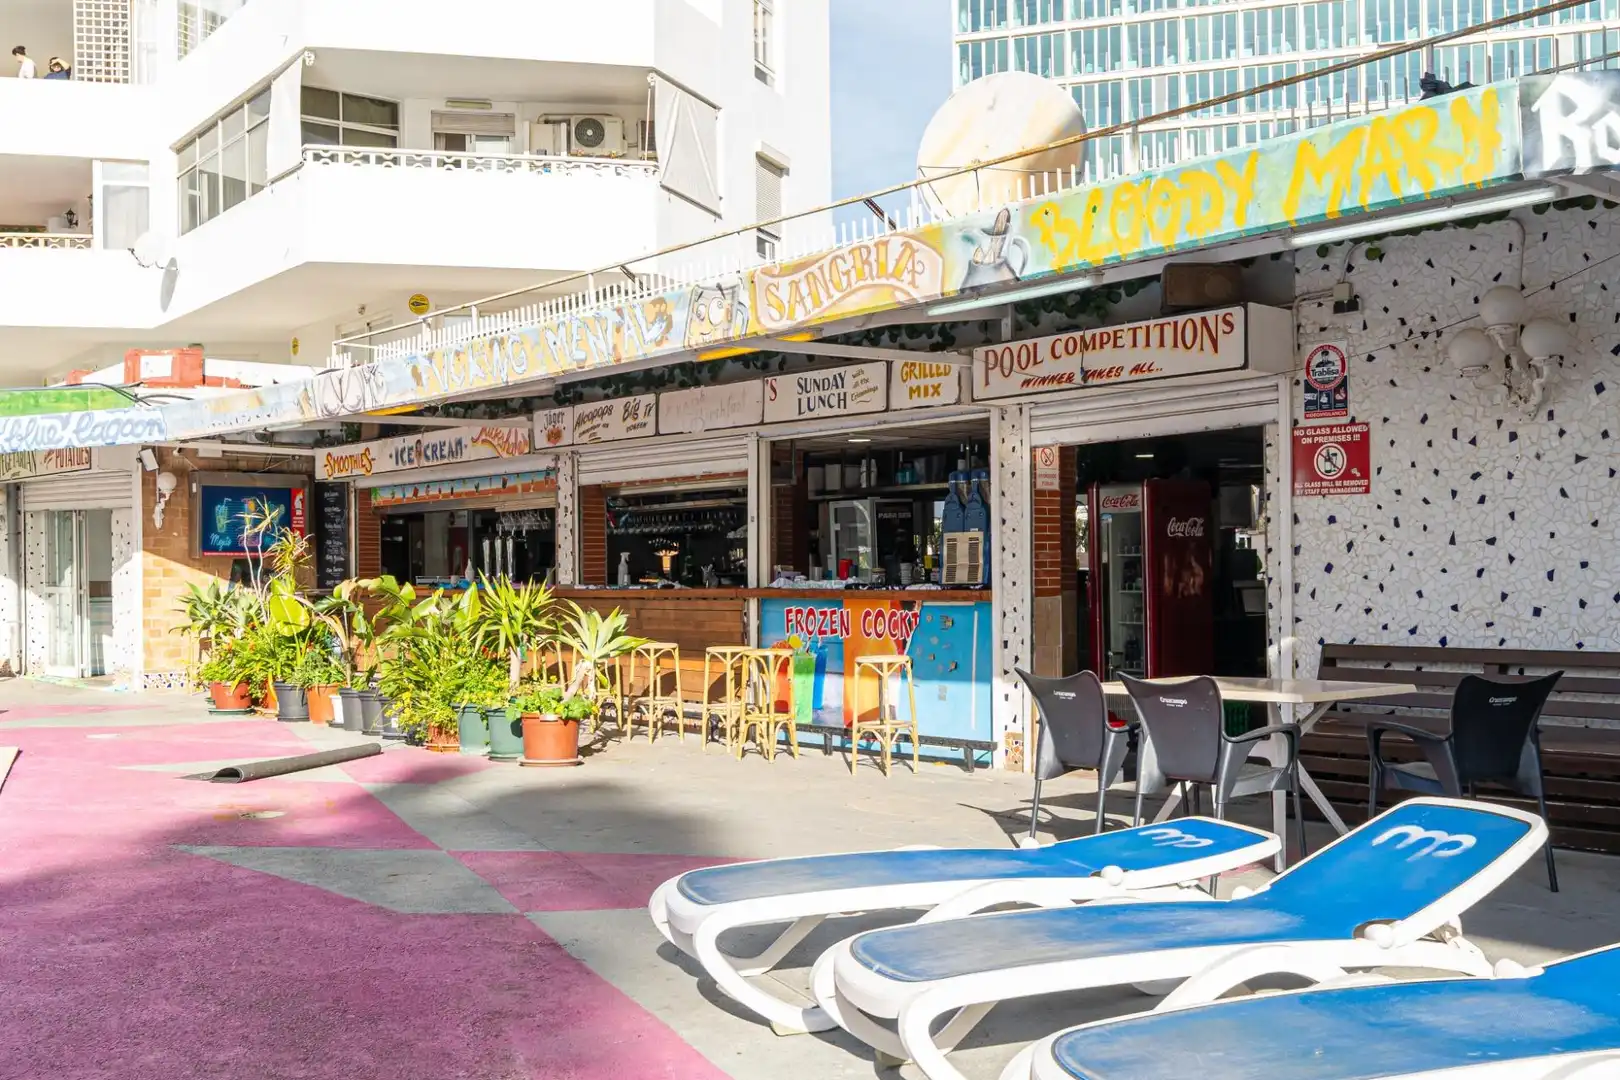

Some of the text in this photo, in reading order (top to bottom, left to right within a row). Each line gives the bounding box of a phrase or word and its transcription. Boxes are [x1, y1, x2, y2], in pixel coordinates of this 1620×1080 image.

[1030, 88, 1502, 273] BLOODY MARY
[764, 239, 926, 322] SANGRIA
[983, 311, 1235, 387] POOL COMPETITIONS
[796, 370, 848, 395] SUNDAY
[900, 361, 952, 384] GRILLED
[1020, 373, 1075, 389] WINNER
[1081, 366, 1123, 384] TAKES
[797, 391, 848, 416] LUNCH
[909, 382, 943, 400] MIX
[574, 404, 614, 431] Alcopops
[622, 397, 642, 422] Big
[1293, 425, 1368, 437] NO GLASS ALLOWED
[1301, 437, 1312, 445] ON
[1314, 435, 1352, 444] PREMISES
[395, 437, 464, 466] ICE CREAM
[1329, 486, 1366, 494] MANAGEMENT
[1167, 516, 1204, 537] Coca-Cola
[784, 606, 851, 639] FROZEN
